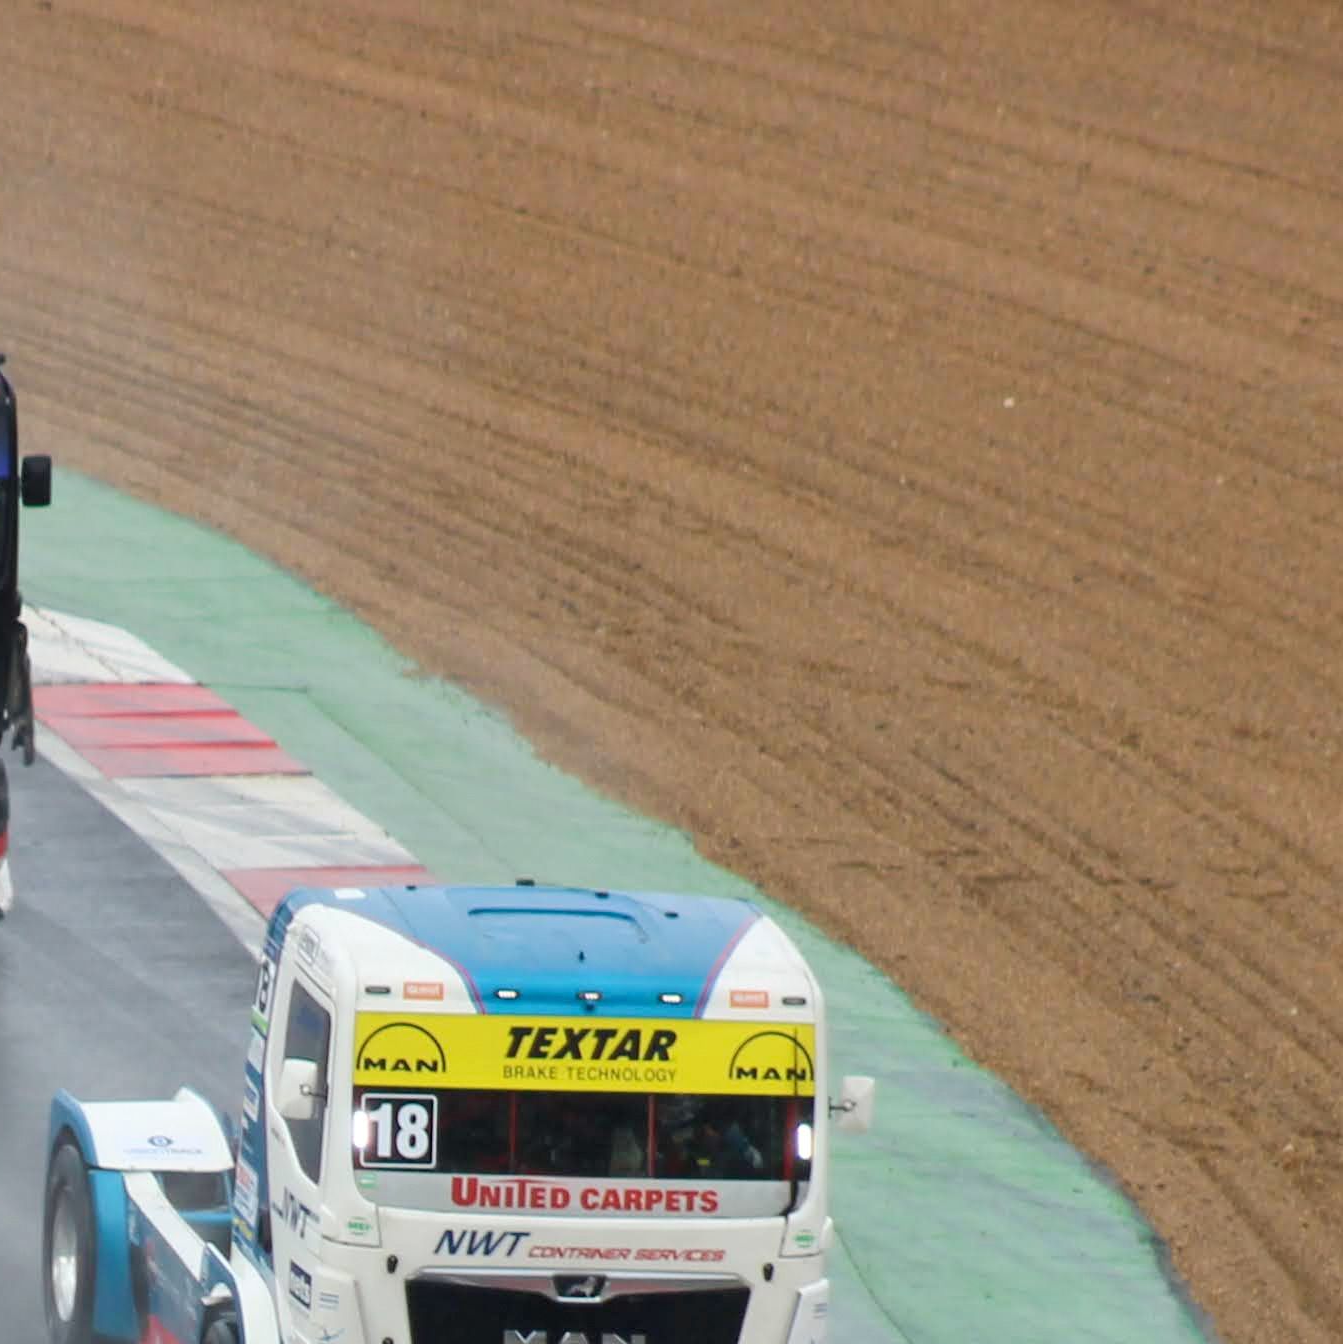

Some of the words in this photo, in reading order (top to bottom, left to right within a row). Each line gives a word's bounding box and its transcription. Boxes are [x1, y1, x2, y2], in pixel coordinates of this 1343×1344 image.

[505, 1026, 678, 1062] TEXTAR
[363, 1057, 439, 1072] MAN
[503, 1065, 559, 1080] BRAKE
[566, 1066, 678, 1083] TECHNOLOGY
[735, 1066, 807, 1081] MAN
[368, 1101, 430, 1160] 18
[579, 1187, 719, 1213] CARPETS
[433, 1229, 531, 1257] NWT
[634, 1247, 728, 1262] SERVICES
